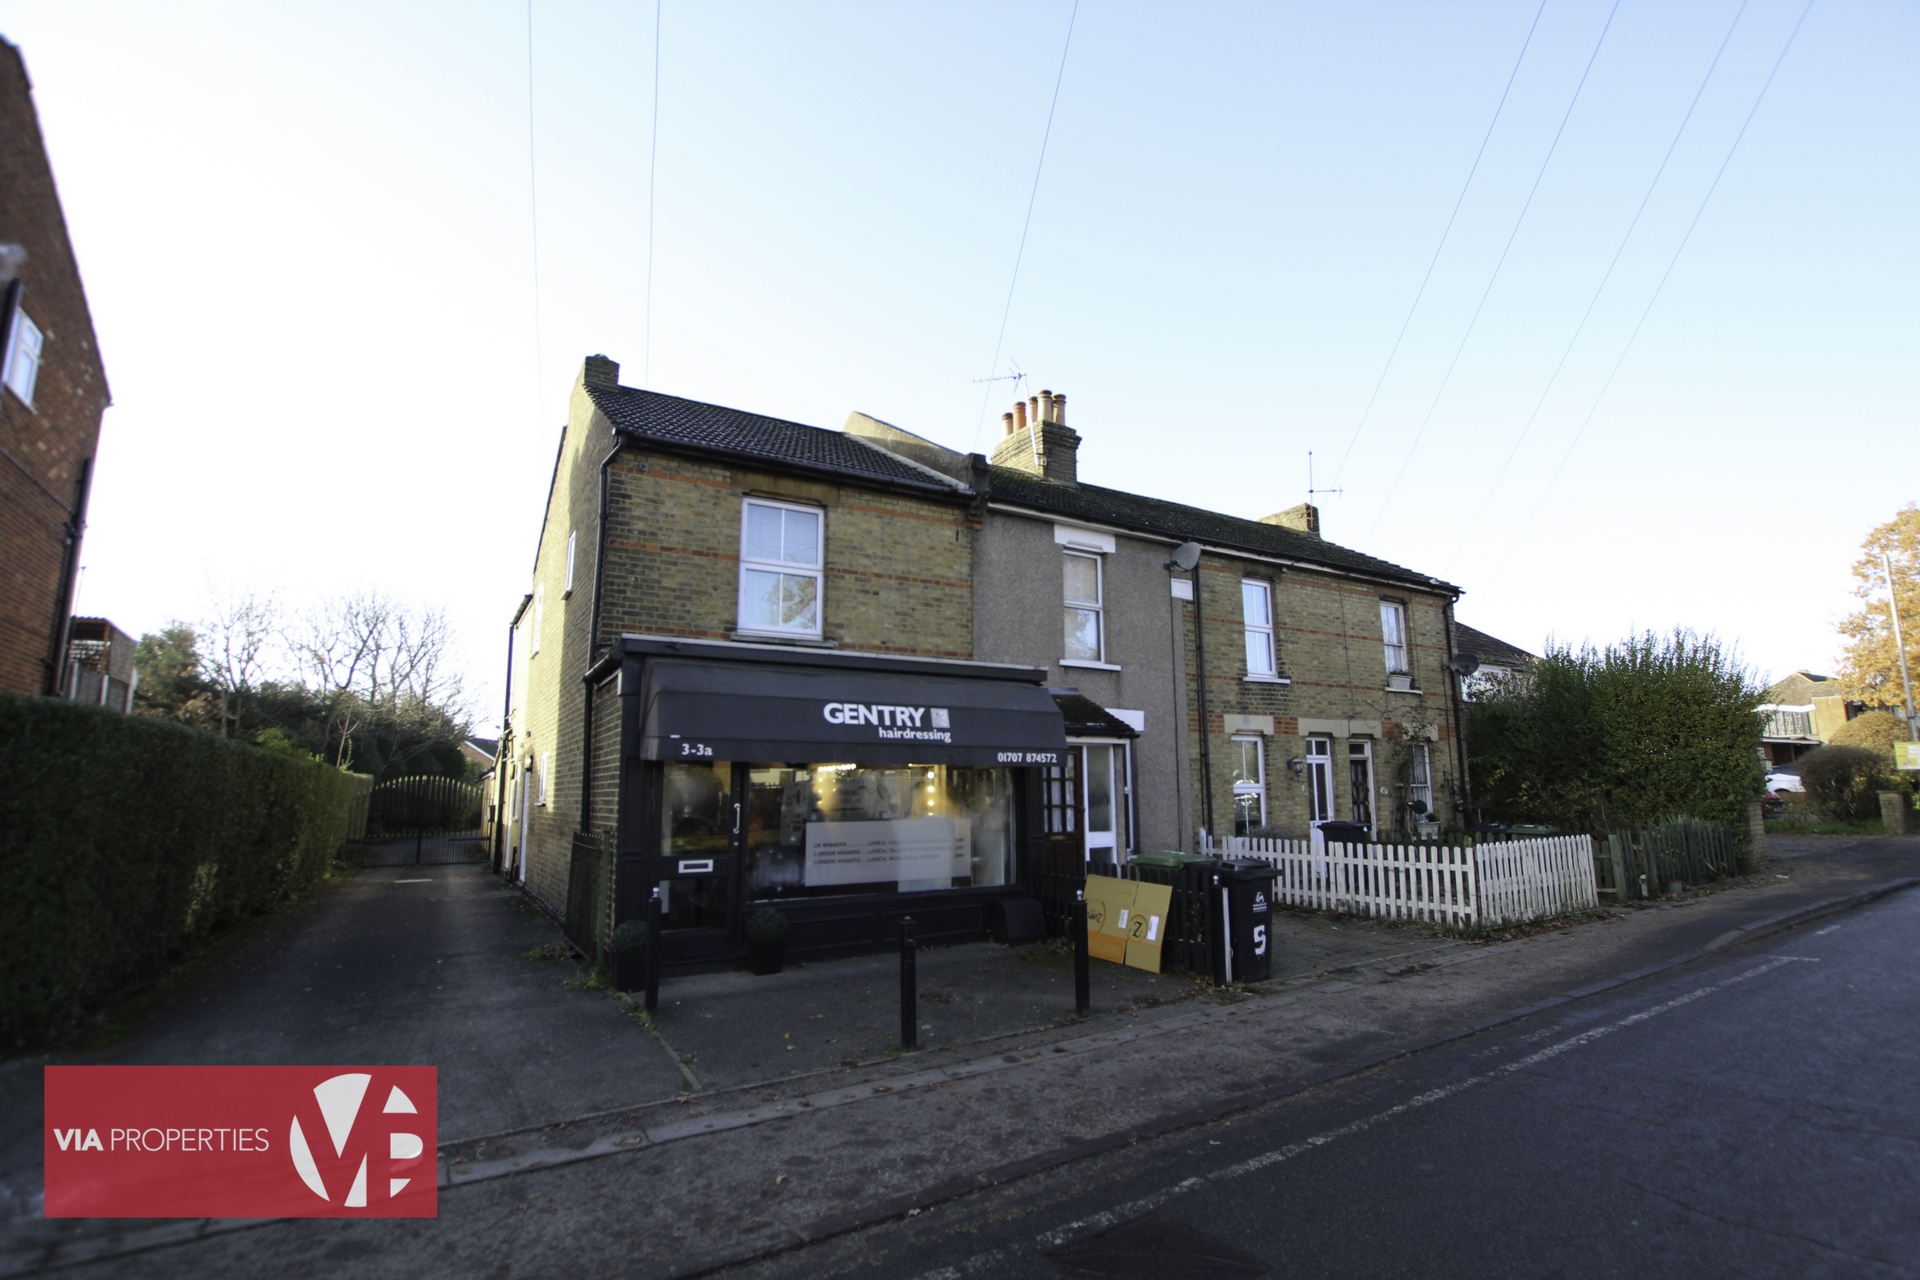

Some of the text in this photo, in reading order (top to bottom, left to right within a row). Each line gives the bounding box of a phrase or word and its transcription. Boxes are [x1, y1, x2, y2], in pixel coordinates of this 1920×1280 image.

[823, 702, 925, 727] GENTRY
[879, 727, 952, 743] hairdressing
[681, 743, 713, 756] 3-3a
[997, 752, 1058, 763] 01707 874572
[1253, 924, 1267, 957] 5
